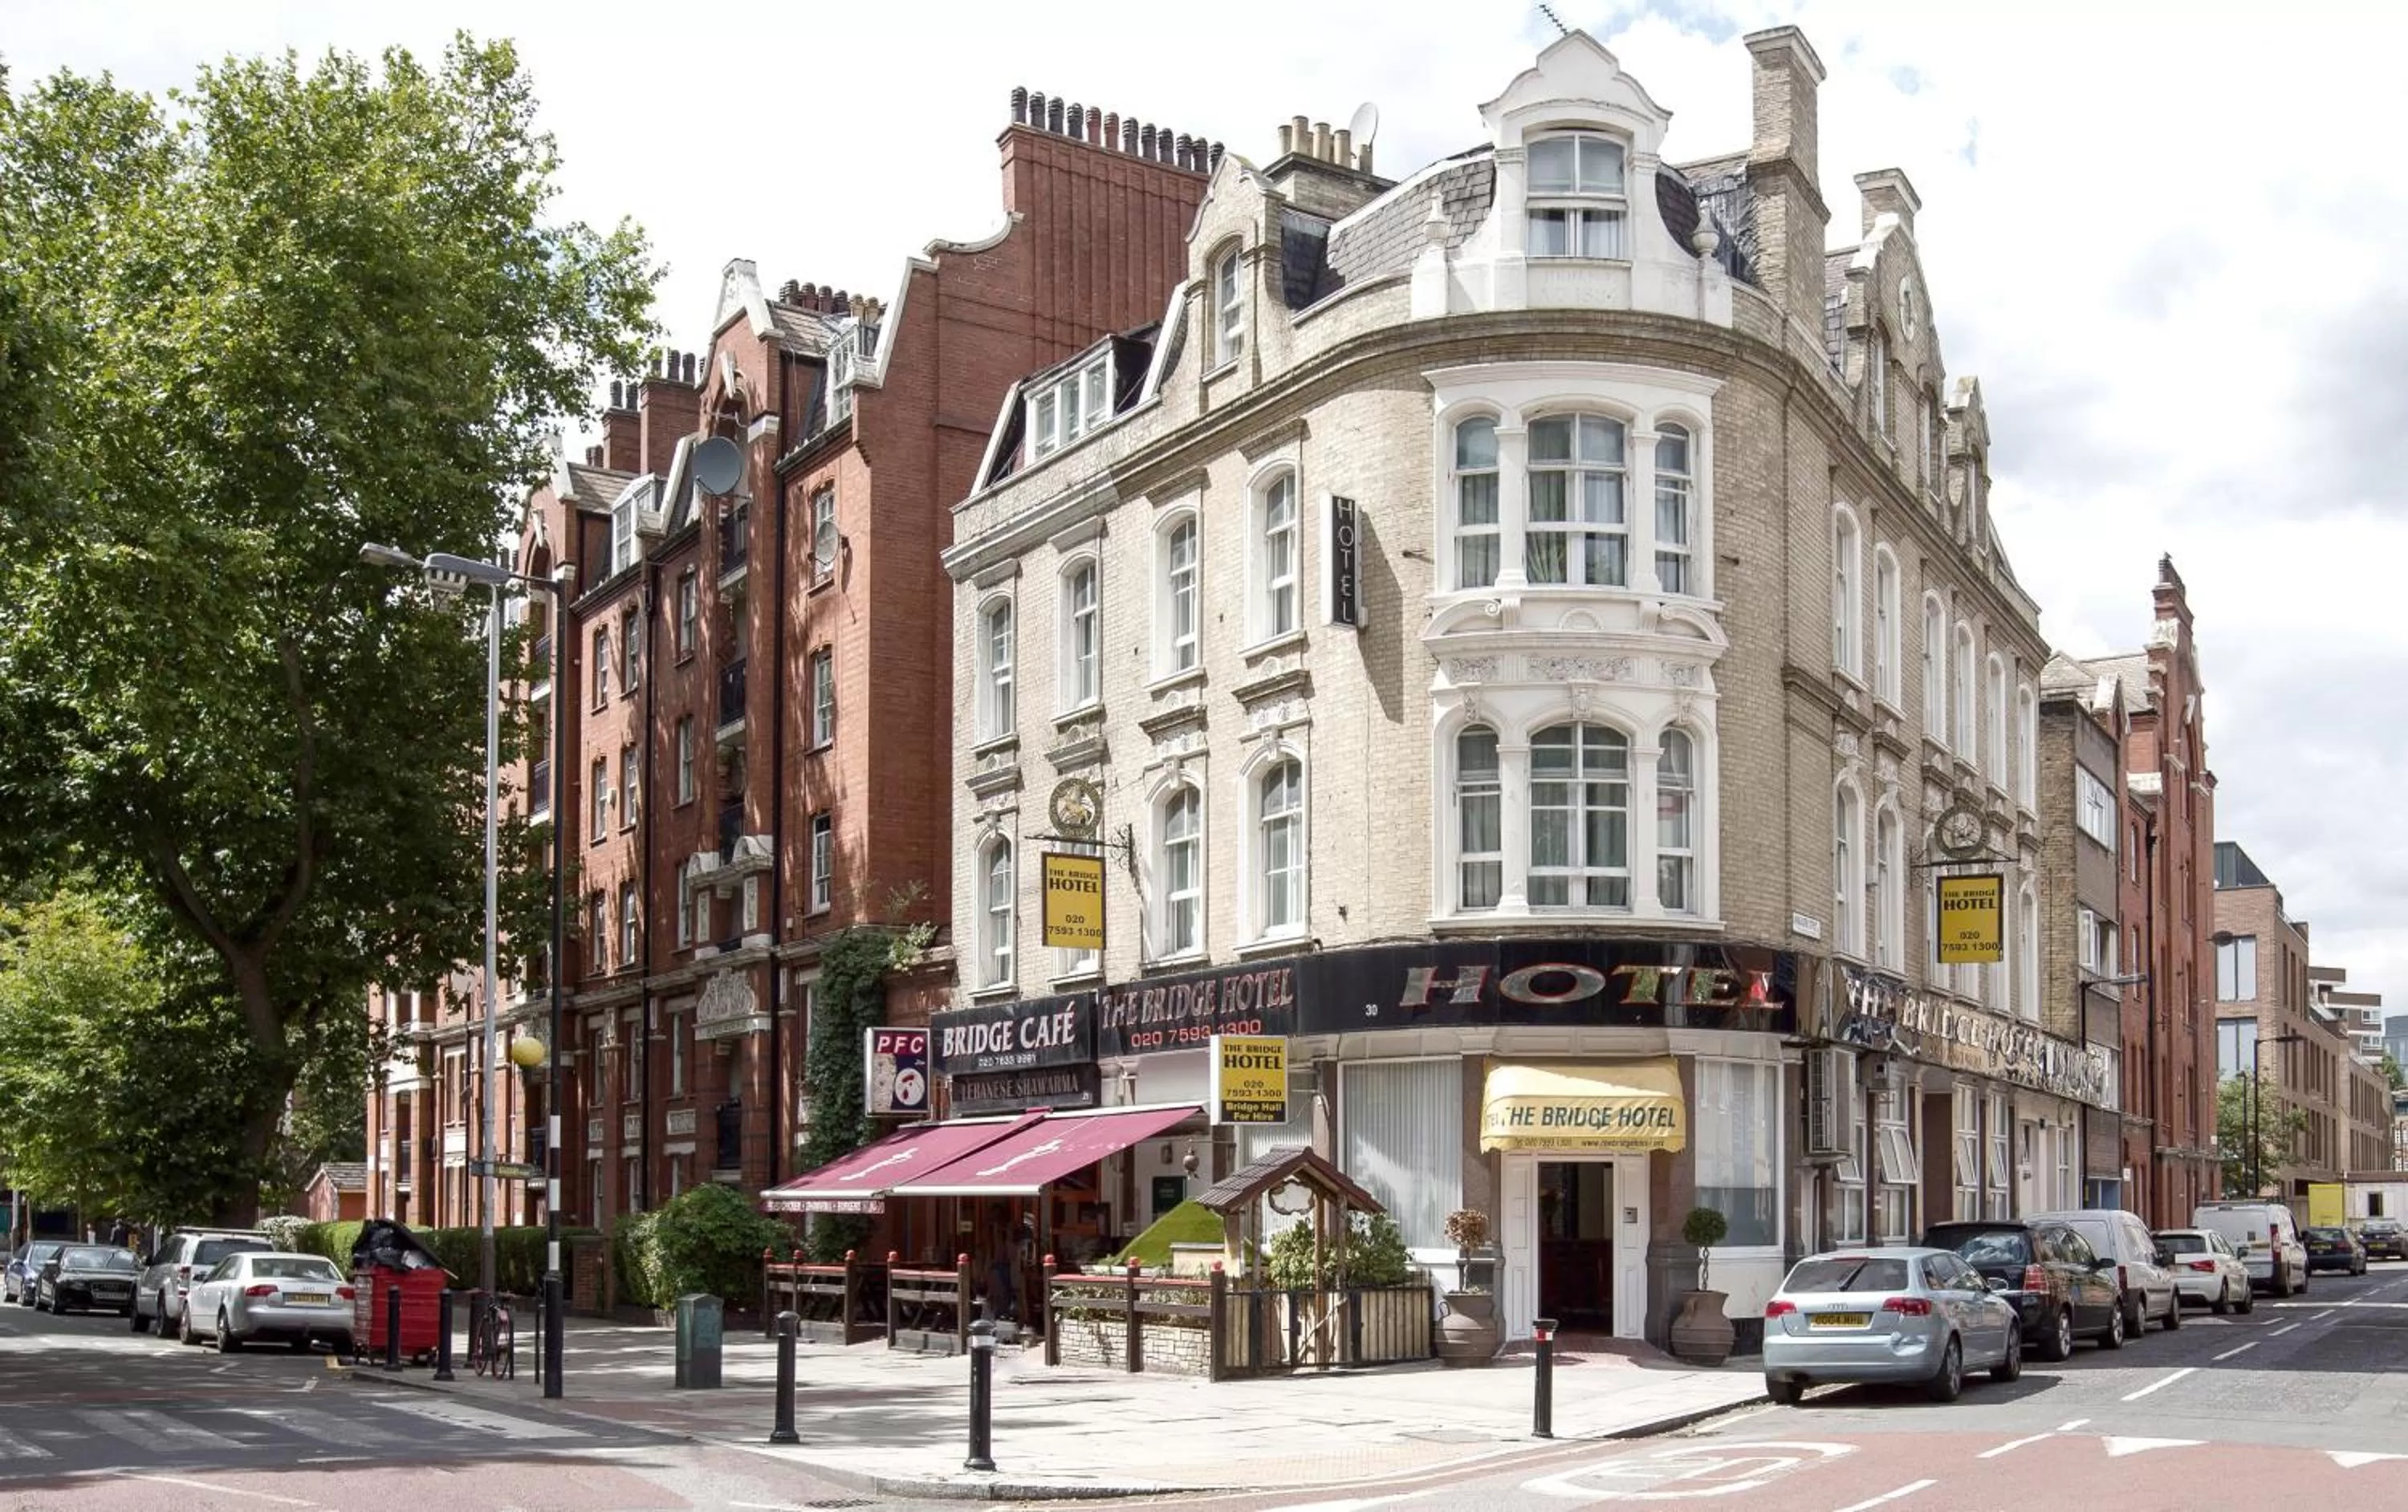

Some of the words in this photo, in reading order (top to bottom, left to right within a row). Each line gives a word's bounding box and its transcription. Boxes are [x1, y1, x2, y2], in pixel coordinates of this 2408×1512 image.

[1337, 498, 1354, 622] HOTEL
[1049, 869, 1064, 877] THE
[1068, 870, 1099, 880] BRIDGE
[1049, 878, 1099, 893] HOTEL
[1963, 888, 1995, 897] BRIDGE
[1943, 898, 1999, 911] HOTEL
[1065, 914, 1084, 924] 020
[1047, 925, 1074, 935] 7593
[1077, 927, 1101, 937] 1300
[1959, 930, 1980, 940] 020
[1971, 941, 1999, 951] 1300
[1399, 962, 1784, 1010] HOTEL
[1102, 990, 1139, 1029] THE
[1141, 978, 1217, 1025] BRIDGE
[1220, 967, 1294, 1014] HOTEL
[942, 1019, 1014, 1058] BRIDGE
[1019, 1000, 1076, 1051] CAFÉ
[1130, 1031, 1163, 1048] 020
[1168, 1025, 1213, 1043] 7593
[1218, 1018, 1262, 1036] 1300
[877, 1035, 925, 1055] PFC
[1223, 1044, 1243, 1054] THE
[1246, 1044, 1283, 1054] BRIDGE
[1223, 1055, 1283, 1070] HOTEL
[1015, 1073, 1079, 1098] SHAWARMA
[1243, 1079, 1264, 1088] 020
[1226, 1089, 1253, 1098] 7593
[1256, 1089, 1282, 1098] 1300
[1226, 1102, 1259, 1112] Bridge
[1262, 1102, 1283, 1112] Hall
[1233, 1112, 1252, 1121] For
[1254, 1112, 1275, 1121] Hire
[1540, 1106, 1613, 1129] BRIDGE
[1617, 1107, 1677, 1128] HOTEL
